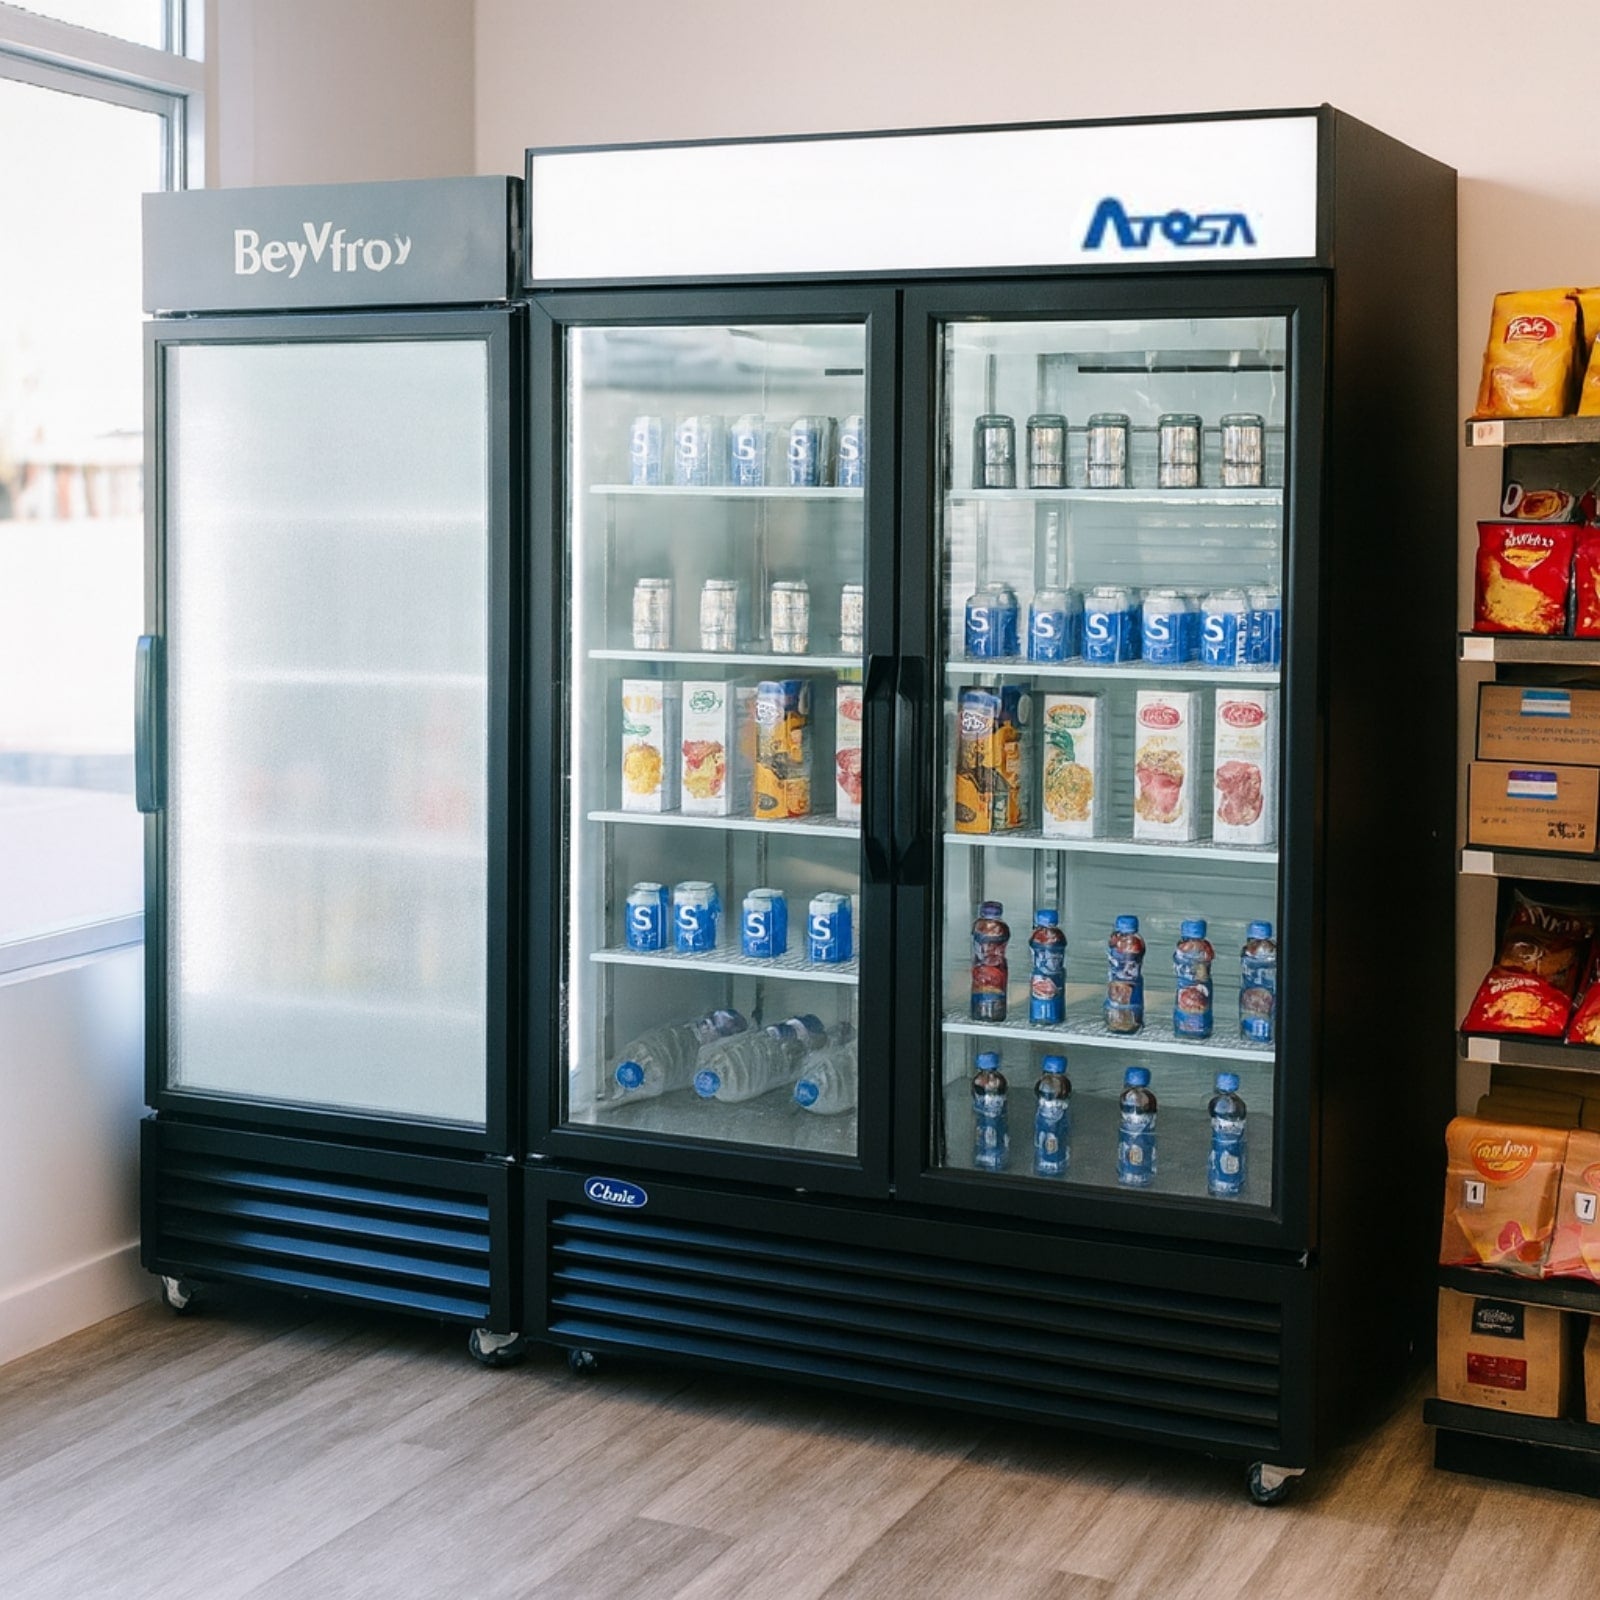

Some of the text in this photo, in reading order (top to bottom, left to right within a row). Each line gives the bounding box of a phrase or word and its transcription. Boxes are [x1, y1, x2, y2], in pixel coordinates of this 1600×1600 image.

[1032, 612, 1054, 637] S
[1086, 613, 1109, 639] S
[1145, 614, 1169, 640] S
[1203, 615, 1224, 641] S
[632, 906, 652, 930] S
[676, 905, 699, 930] S
[746, 912, 766, 938] S
[809, 916, 831, 940] S
[1471, 1185, 1477, 1199] 1
[1583, 1199, 1591, 1213] 7
